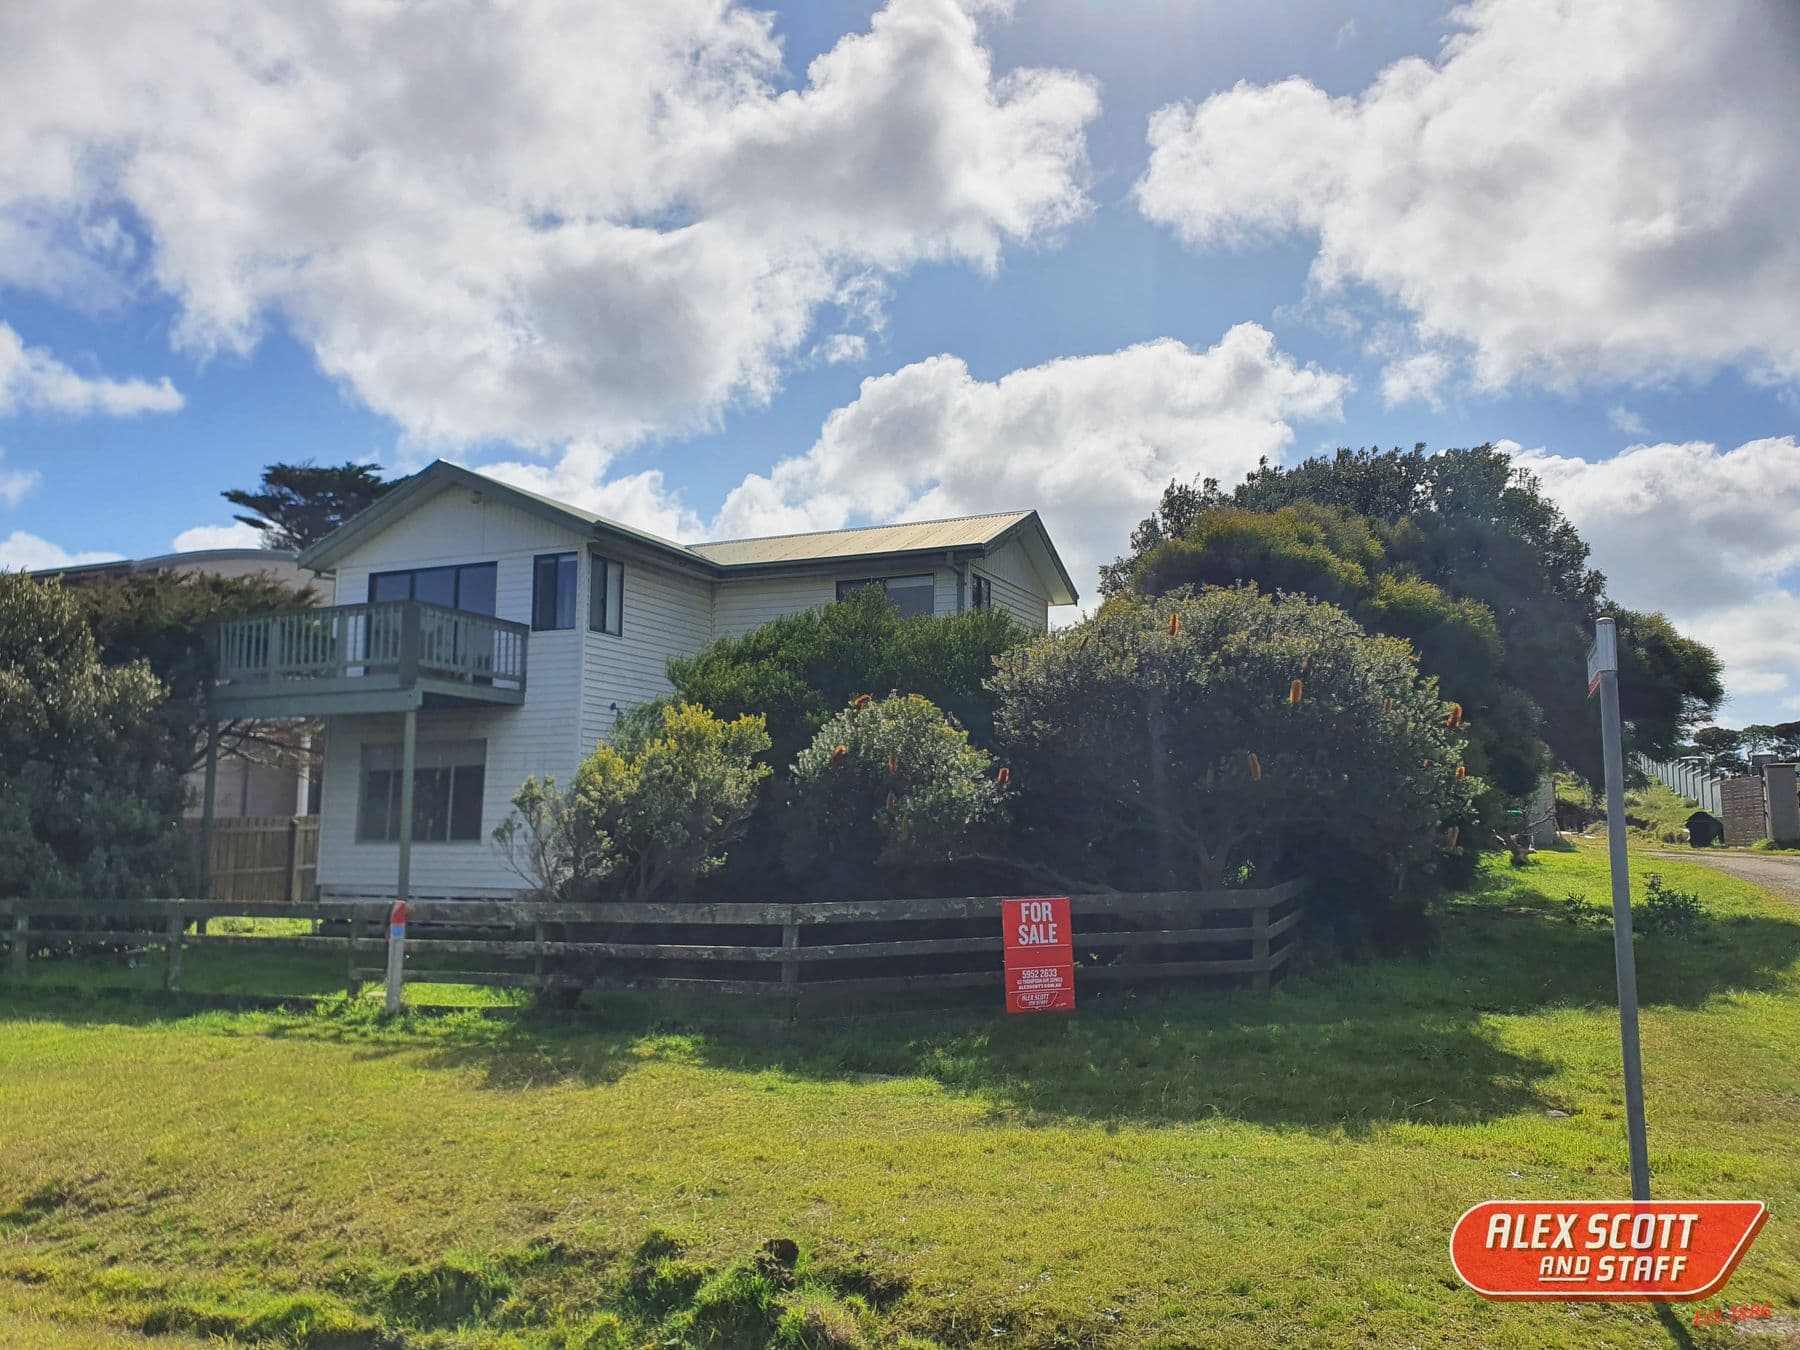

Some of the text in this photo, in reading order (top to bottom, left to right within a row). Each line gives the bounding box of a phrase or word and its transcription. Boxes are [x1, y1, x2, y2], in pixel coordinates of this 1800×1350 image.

[1021, 902, 1053, 923] FOR
[1018, 924, 1058, 945] SALE
[1022, 969, 1039, 979] 5952
